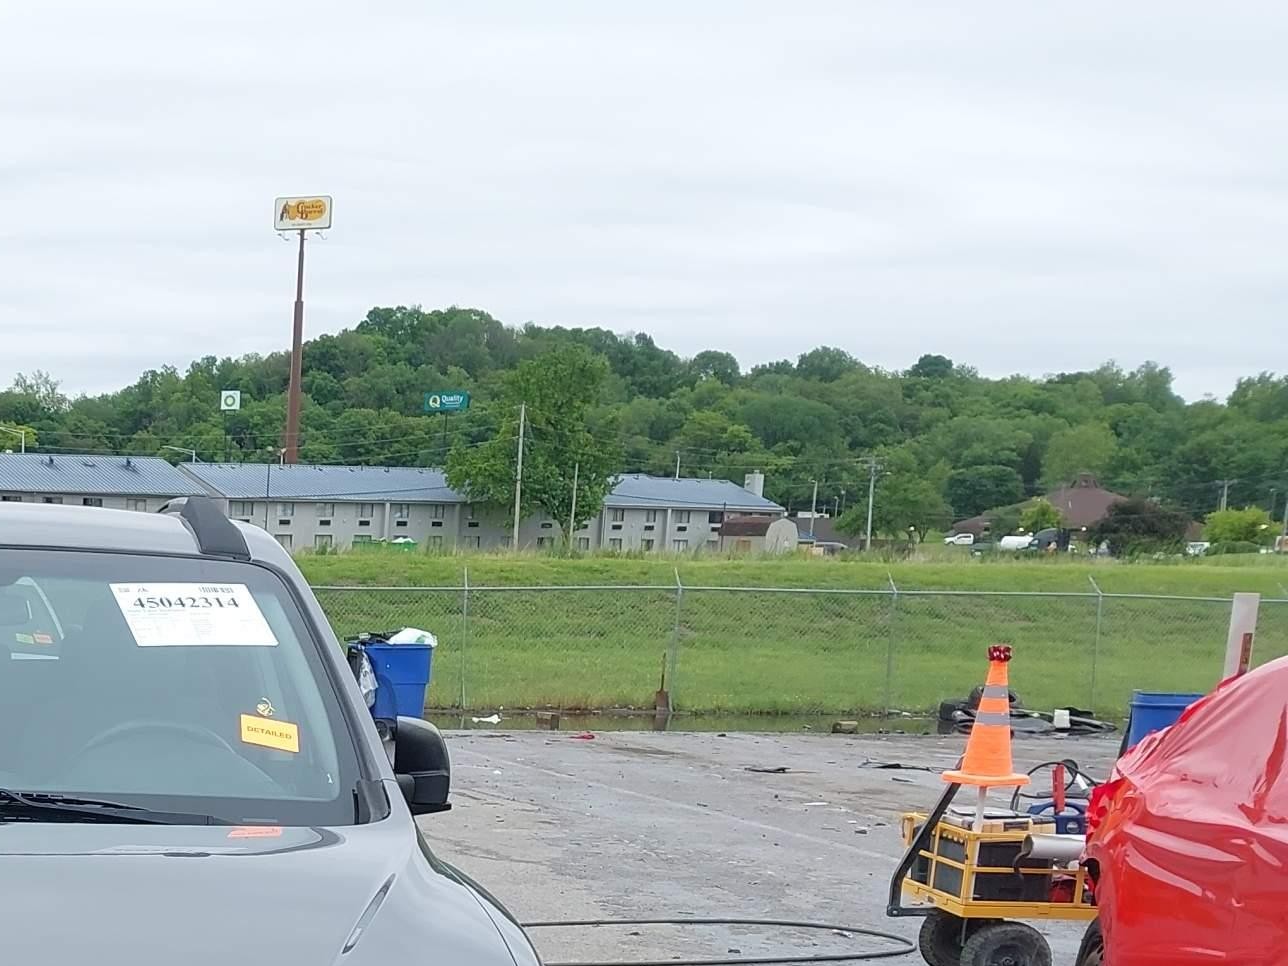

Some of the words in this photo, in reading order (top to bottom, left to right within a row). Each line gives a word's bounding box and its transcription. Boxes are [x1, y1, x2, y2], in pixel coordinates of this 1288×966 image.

[441, 394, 464, 404] Quality
[133, 597, 239, 608] 45042314
[246, 725, 293, 740] DETAILED
